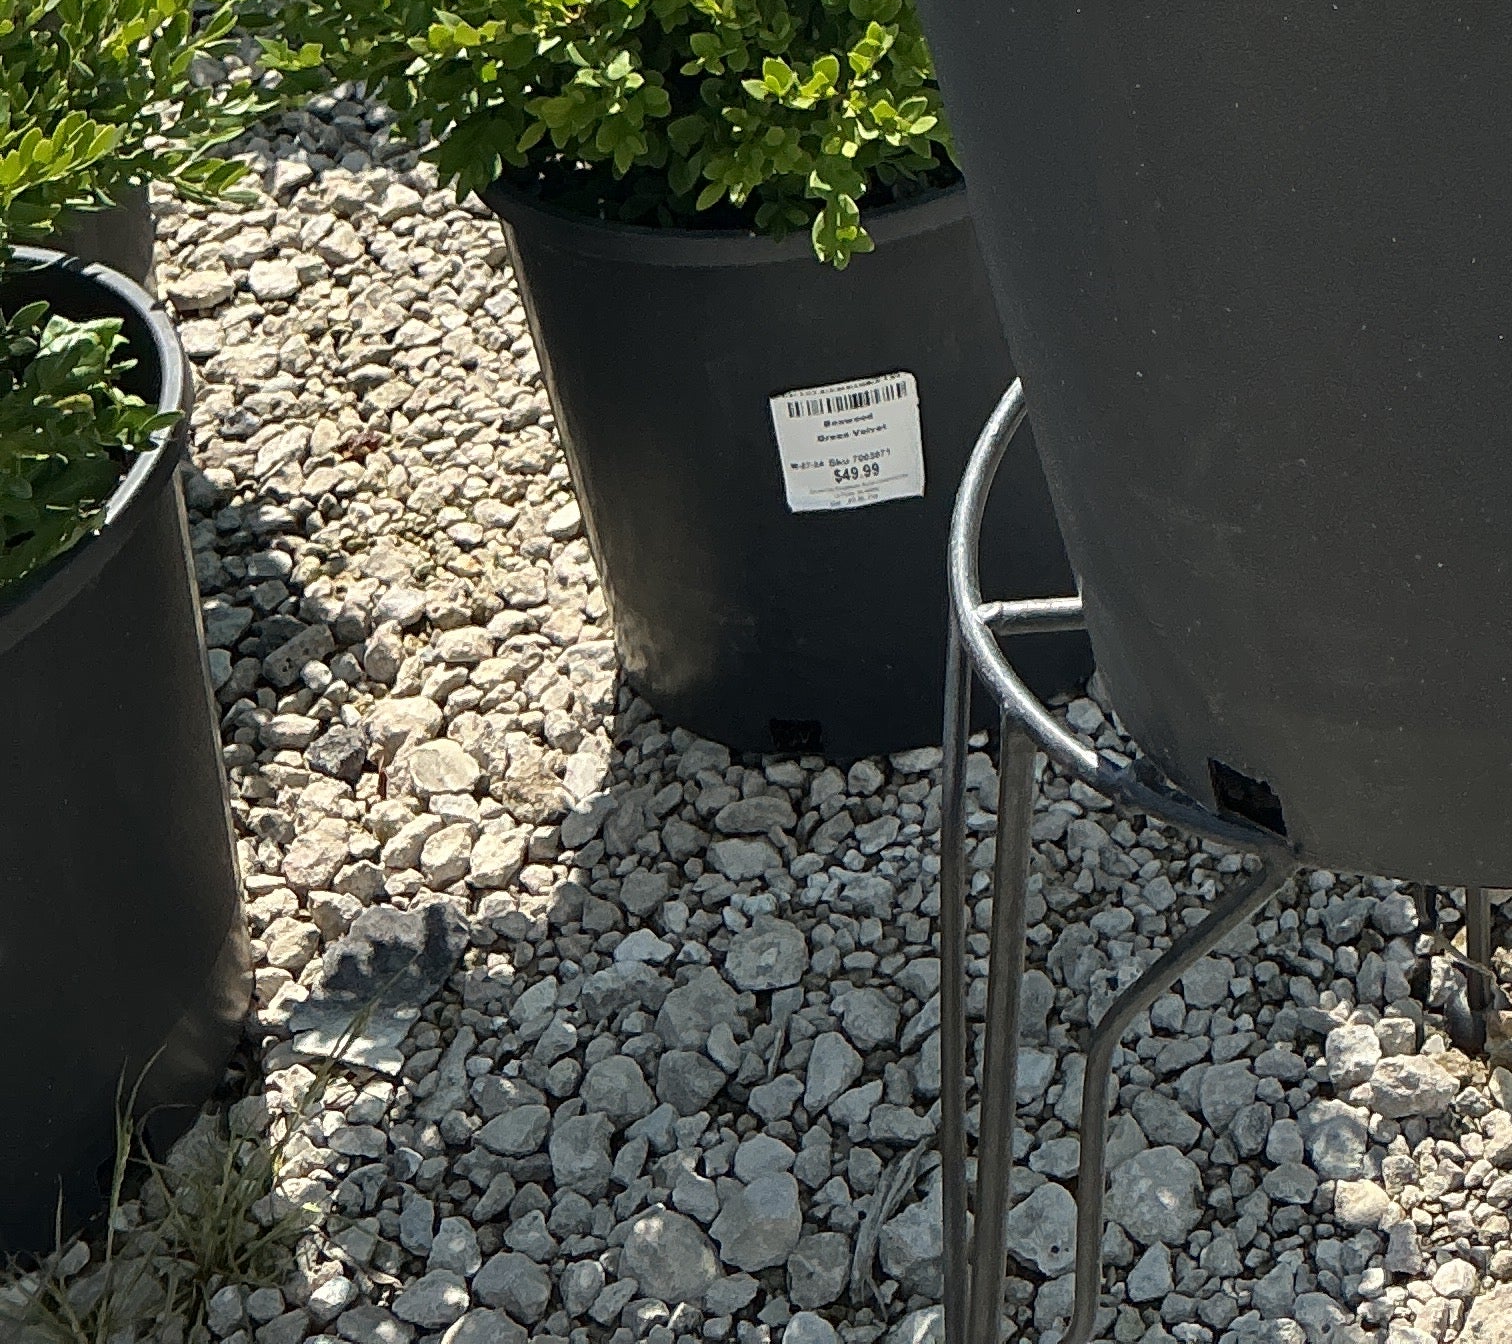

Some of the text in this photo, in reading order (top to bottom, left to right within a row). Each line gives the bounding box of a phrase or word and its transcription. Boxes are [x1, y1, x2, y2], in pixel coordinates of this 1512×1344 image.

[823, 412, 874, 428] Boxwood
[817, 423, 888, 442] Green Velvet
[833, 462, 880, 484] $49.99
